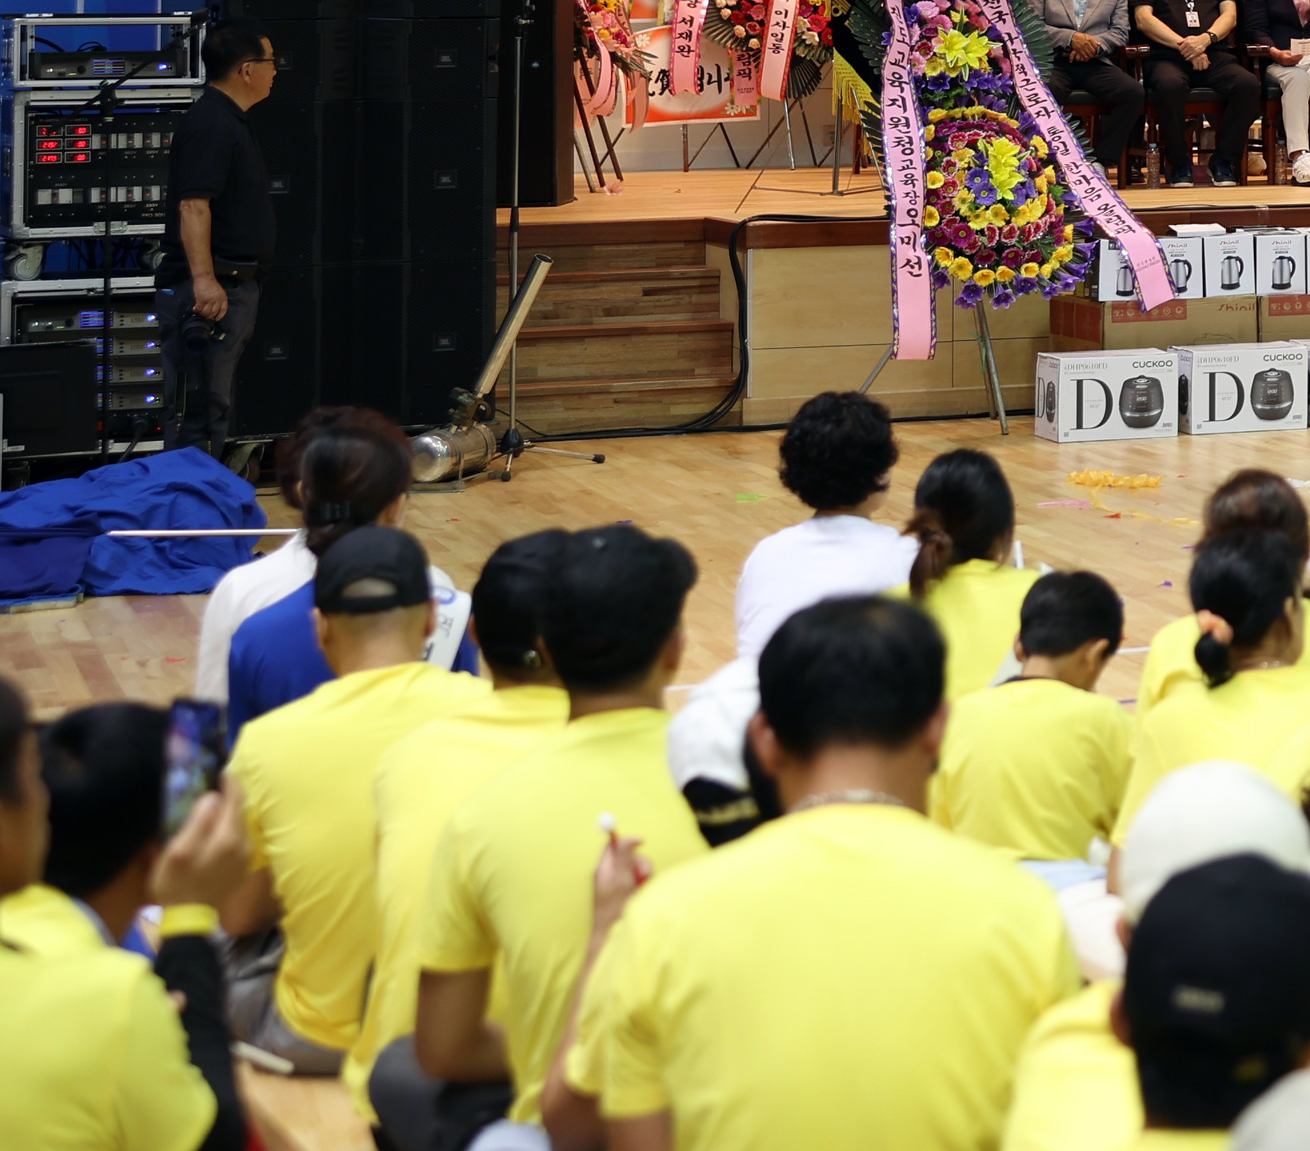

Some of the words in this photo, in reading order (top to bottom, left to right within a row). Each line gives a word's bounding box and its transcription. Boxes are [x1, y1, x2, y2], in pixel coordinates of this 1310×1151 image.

[1132, 360, 1173, 368] CUCKOO
[1263, 353, 1303, 362] CUCKOO
[1070, 378, 1113, 430] D
[1203, 371, 1245, 423] D
